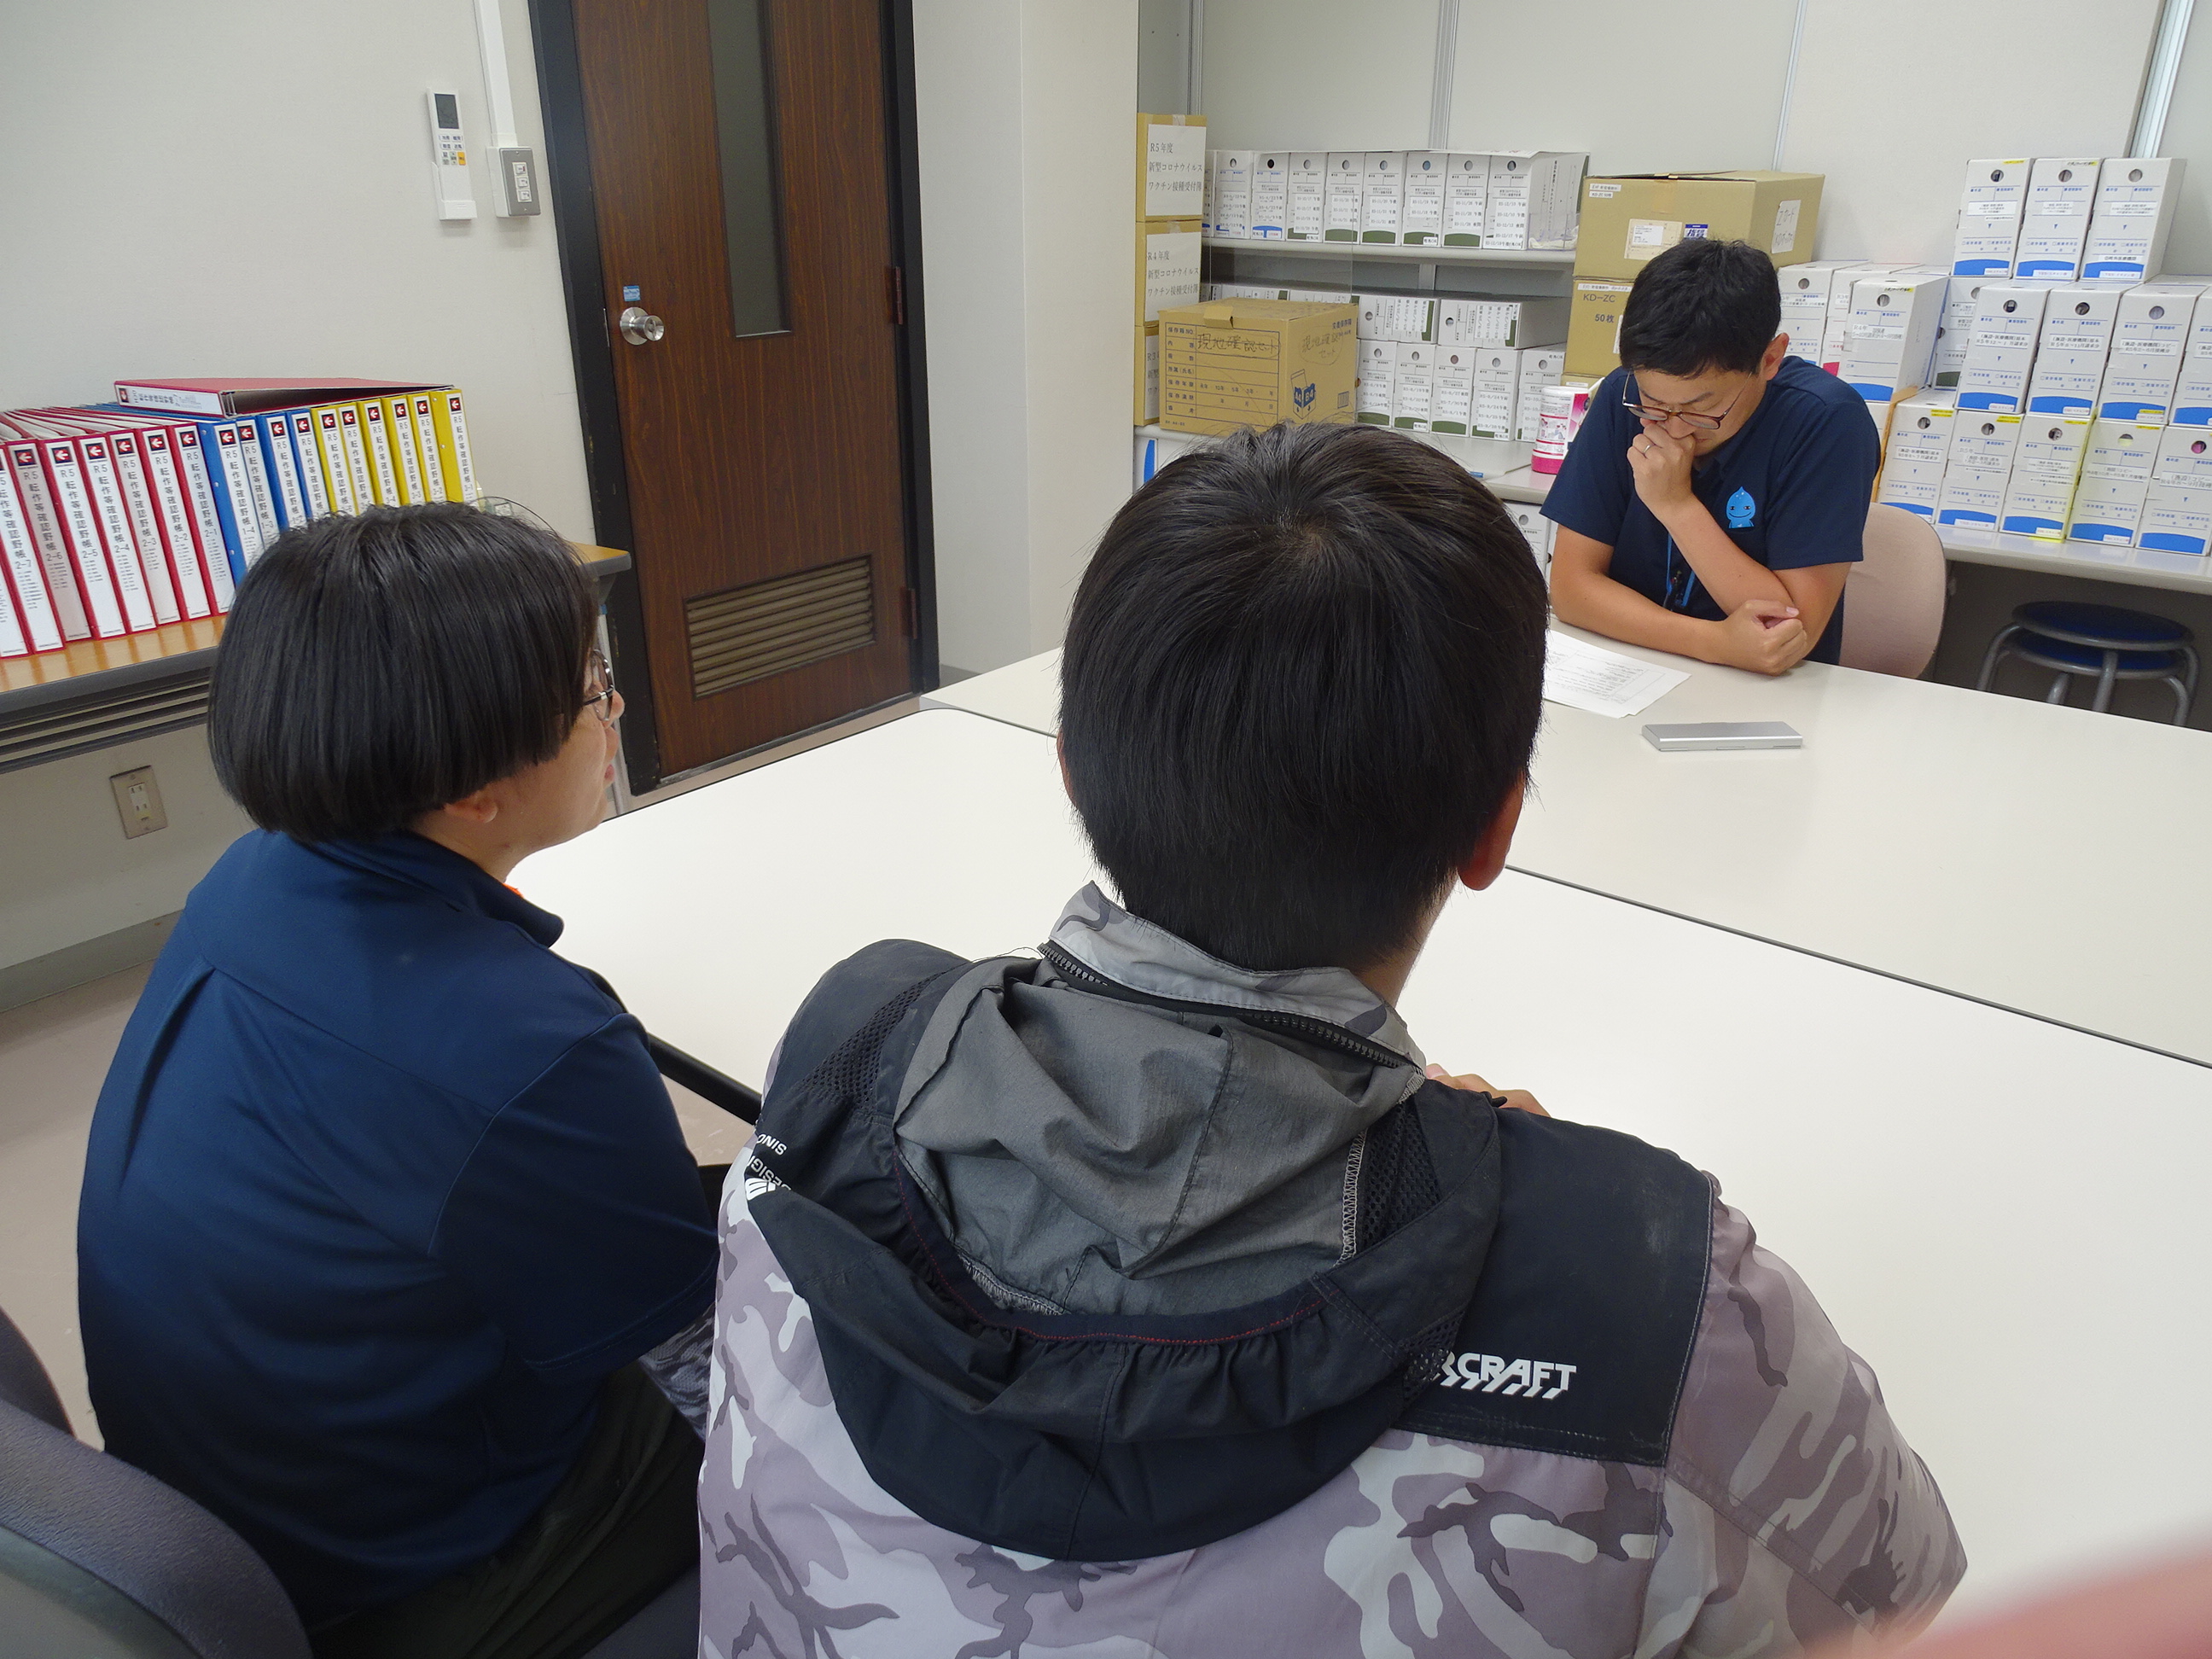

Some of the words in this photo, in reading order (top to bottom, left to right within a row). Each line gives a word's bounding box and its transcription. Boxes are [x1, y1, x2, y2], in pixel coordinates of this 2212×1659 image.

[1150, 143, 1173, 154] R5年度
[1149, 161, 1202, 172] 新型コロナウイルス
[1148, 181, 1202, 192] ワクチン接種受付簿
[1147, 250, 1170, 261] R4年度
[1148, 267, 1199, 280] 新型コロナウイルス
[1583, 294, 1616, 303] KD-ZC
[1594, 314, 1615, 323] 50枚
[276, 441, 288, 450] R5
[302, 437, 312, 445] R5
[245, 445, 257, 454] R5
[186, 452, 200, 461] R5
[225, 451, 237, 459] R5
[93, 464, 108, 474] R5
[23, 472, 39, 480] R5
[46, 552, 64, 562] 2-6
[60, 469, 76, 478] R5
[82, 549, 99, 559] 2-5
[143, 538, 157, 547] 2-3
[174, 534, 189, 543] 2-2
